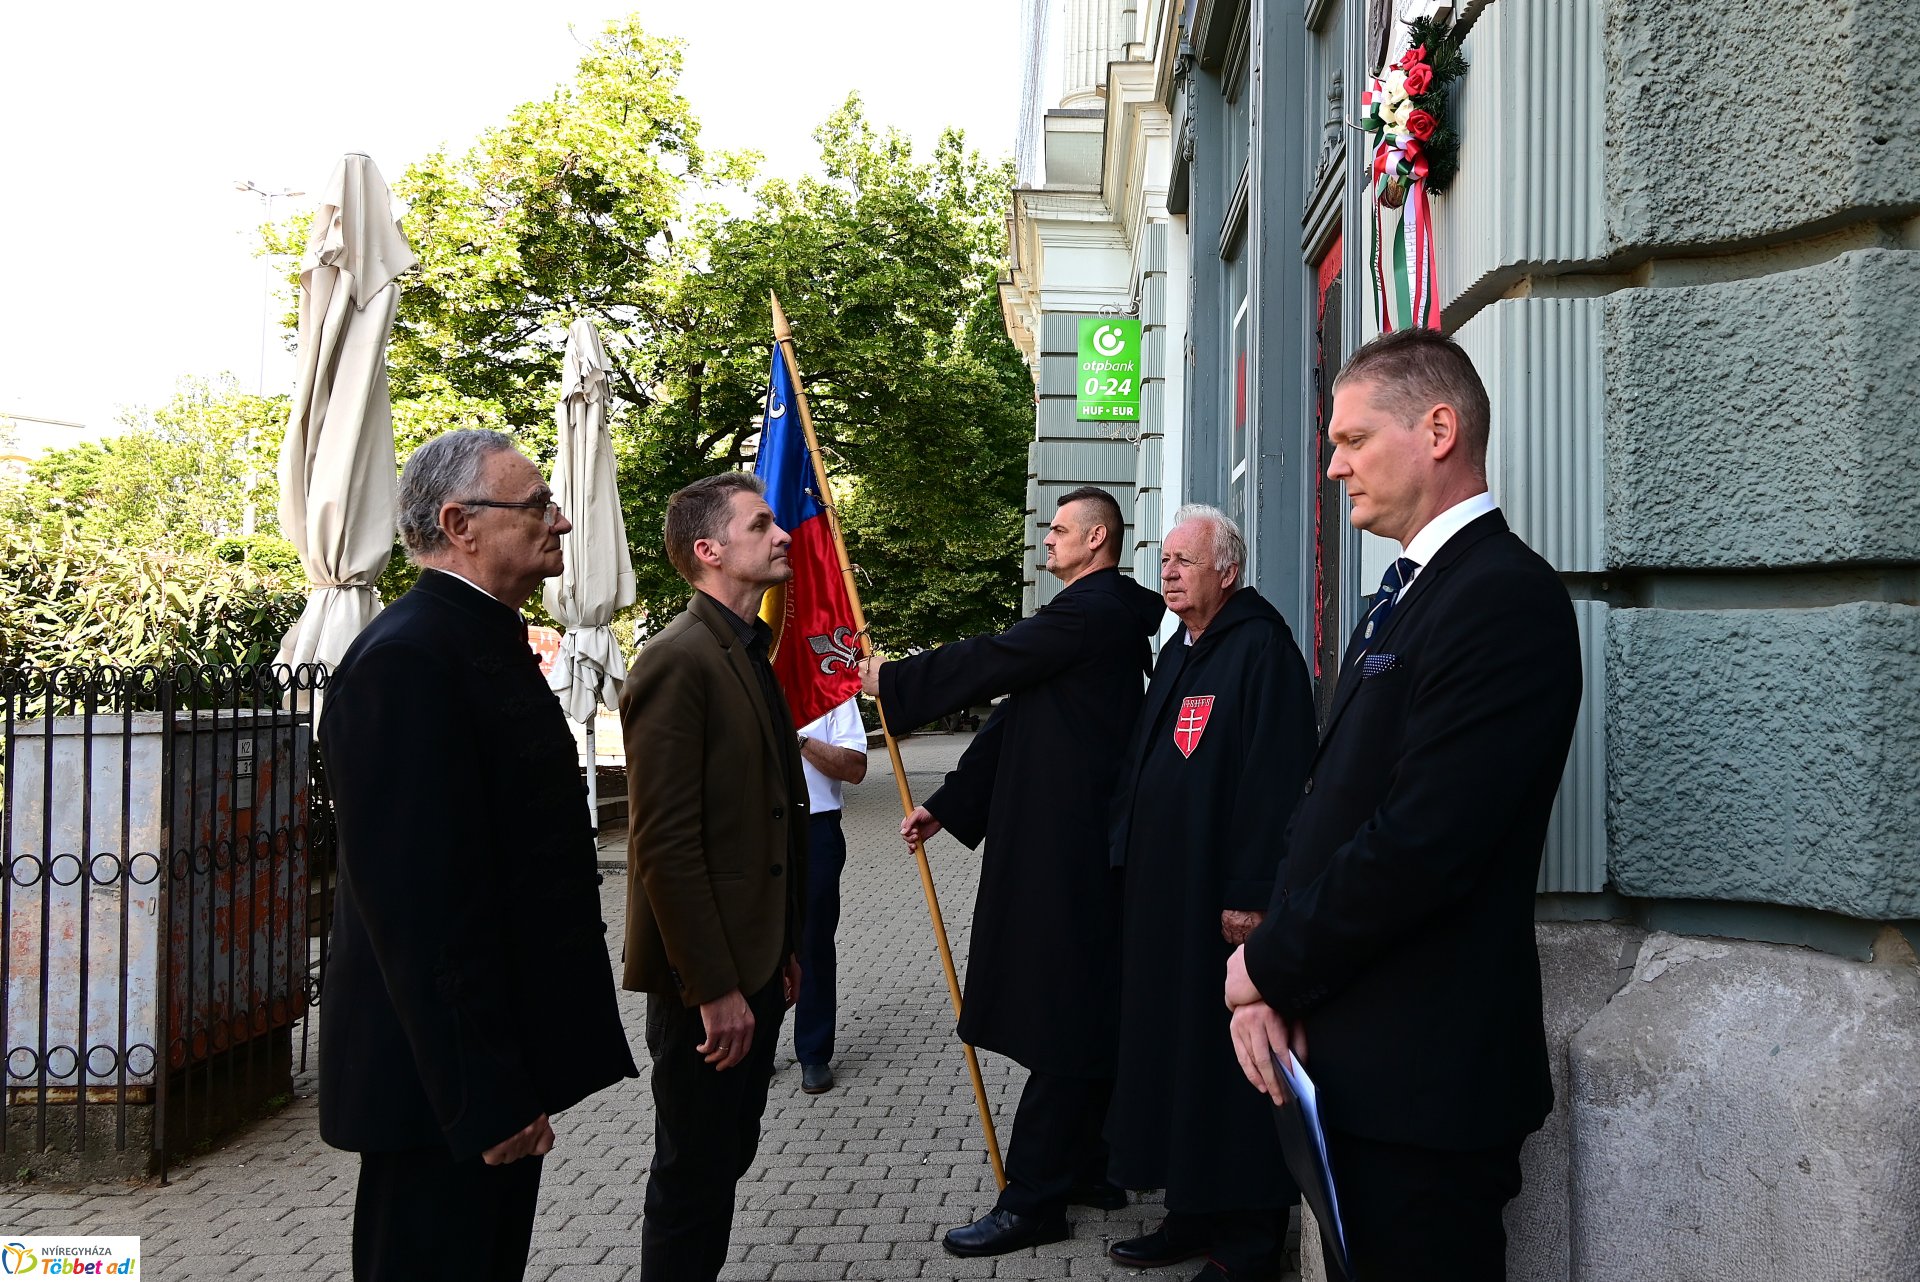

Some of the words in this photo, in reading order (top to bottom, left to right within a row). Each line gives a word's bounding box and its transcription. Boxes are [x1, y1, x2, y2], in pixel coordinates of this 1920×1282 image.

[1082, 360, 1134, 374] otpbank
[1084, 377, 1132, 396] 0-24
[1082, 406, 1104, 415] HUF
[1112, 406, 1134, 416] EUR
